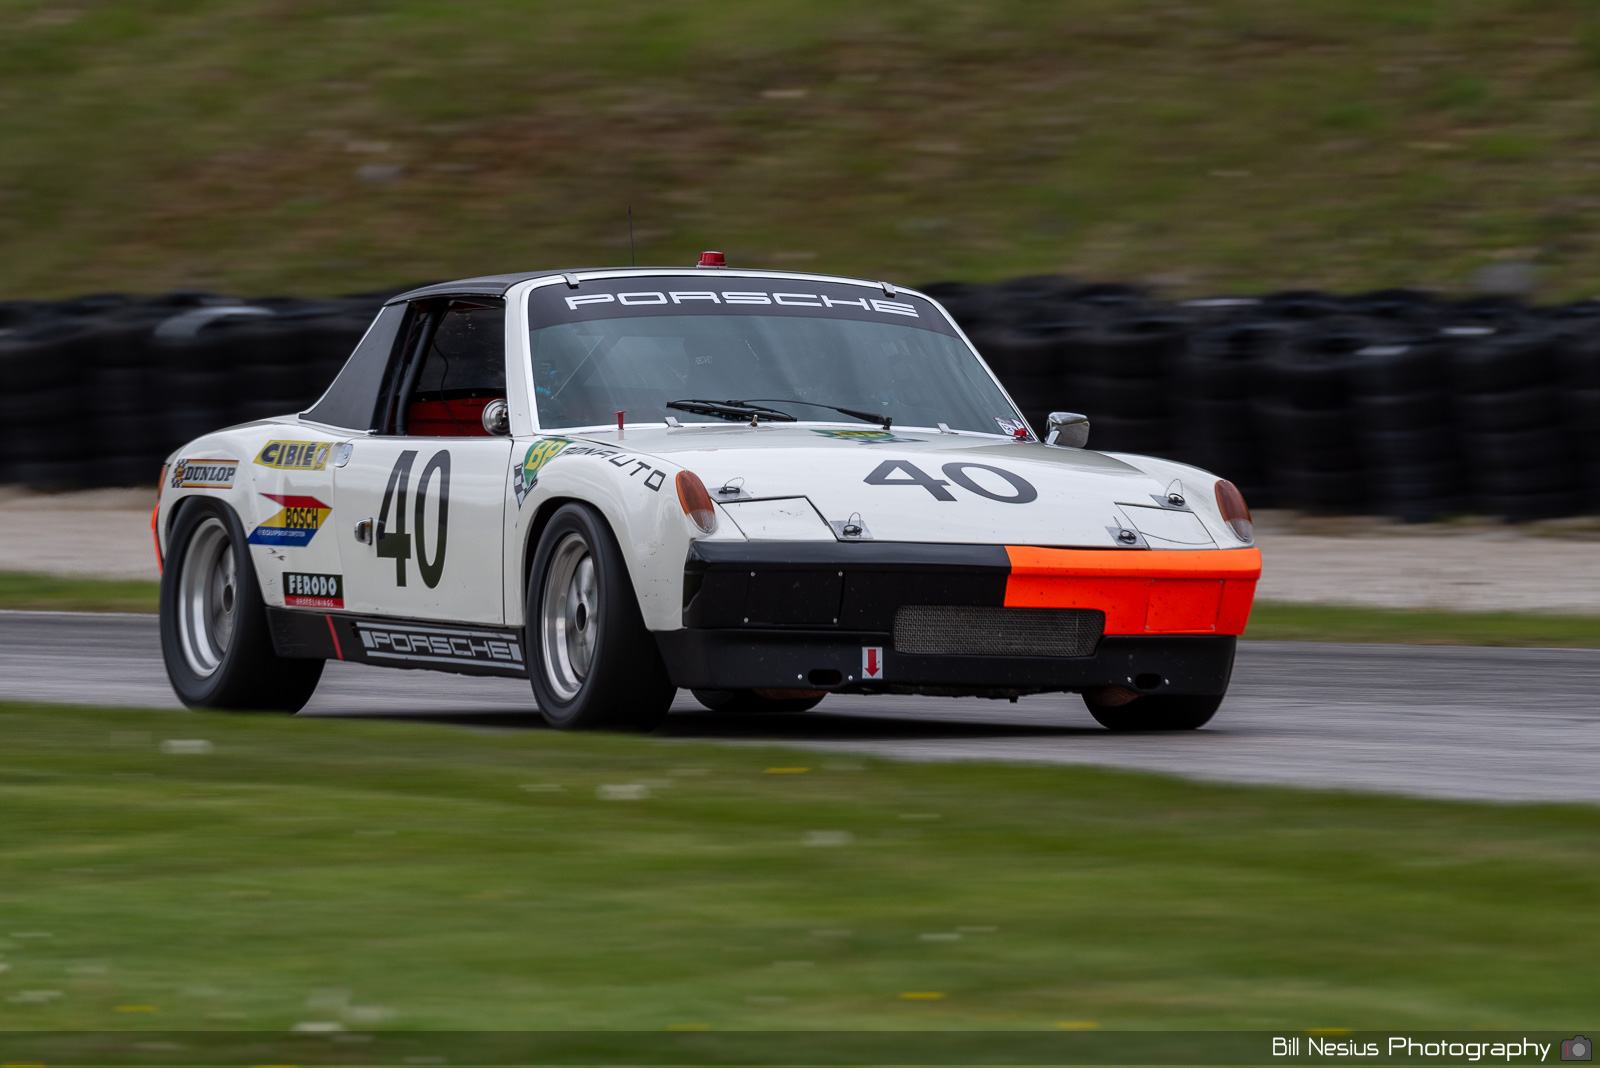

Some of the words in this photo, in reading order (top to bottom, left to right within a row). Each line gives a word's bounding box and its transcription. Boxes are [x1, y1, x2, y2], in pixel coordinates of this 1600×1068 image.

[564, 290, 919, 318] PORSCHE
[260, 442, 317, 467] CIBIÉ
[525, 439, 567, 470] BP
[184, 466, 236, 481] DUNLOP
[863, 459, 1038, 504] 40
[285, 507, 319, 529] BOSCH
[376, 449, 451, 589] 40
[288, 574, 337, 597] FERODO
[370, 631, 511, 660] PORSCHE
